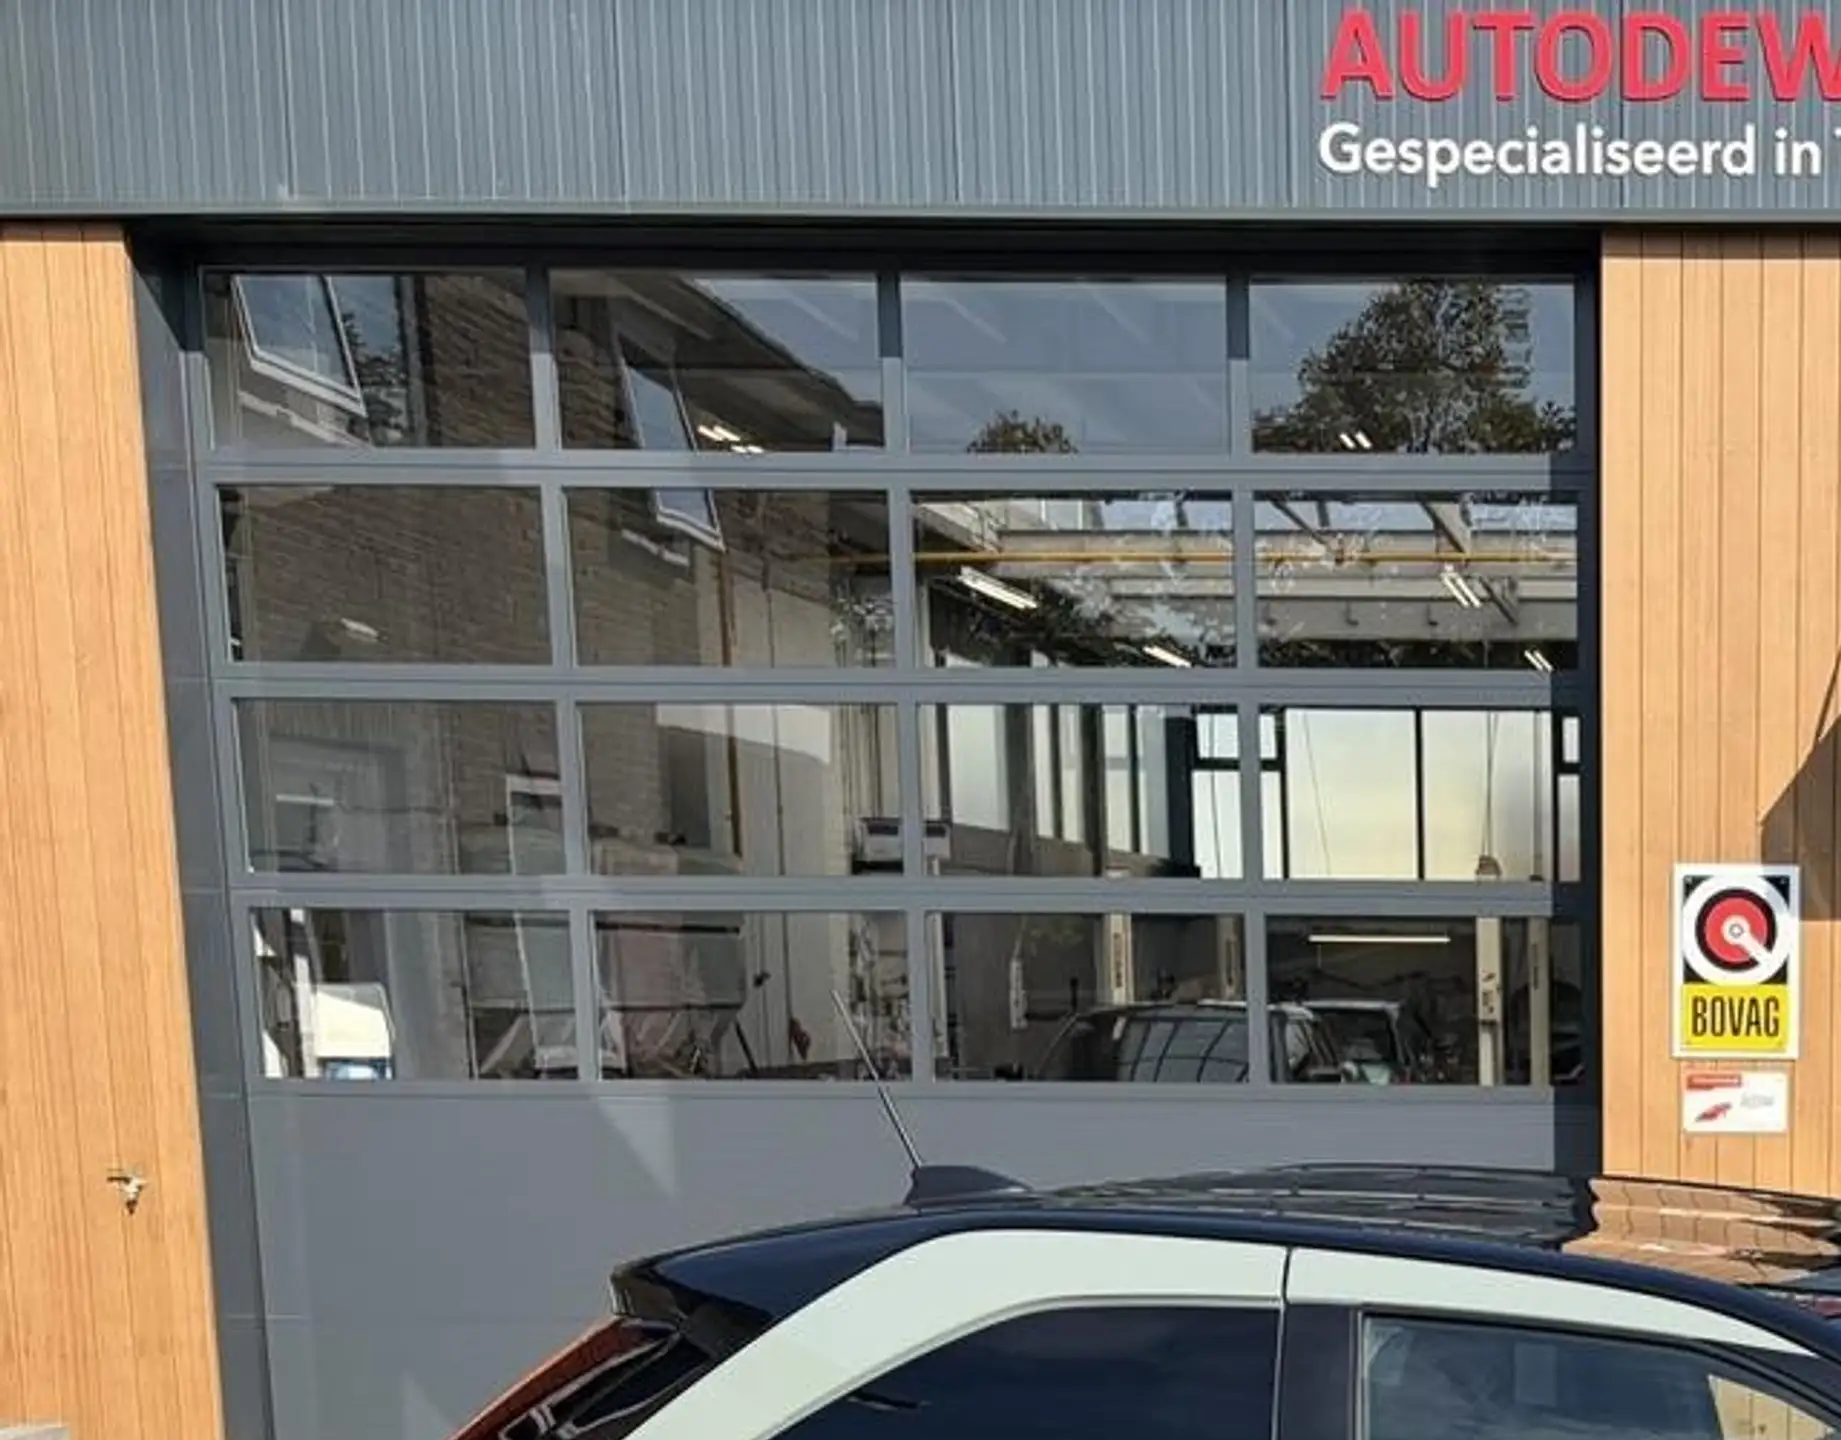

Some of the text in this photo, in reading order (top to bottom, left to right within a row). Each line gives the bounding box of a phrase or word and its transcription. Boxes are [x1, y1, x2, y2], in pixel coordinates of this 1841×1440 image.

[1318, 122, 1757, 189] Gespecialiseerd
[1775, 126, 1822, 176] in
[1691, 995, 1779, 1037] BOVAG
